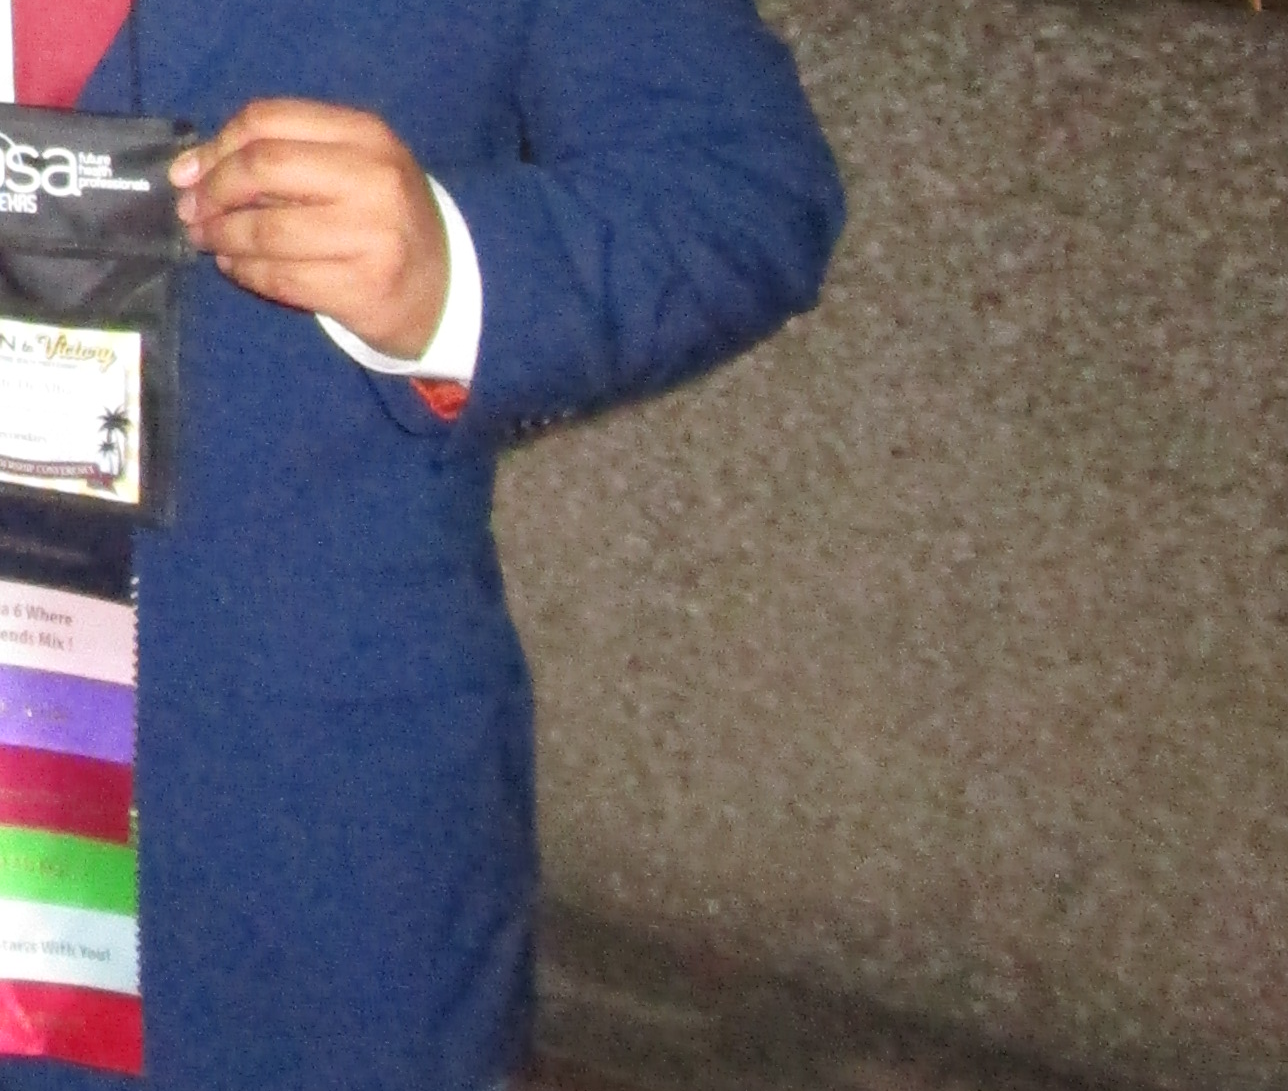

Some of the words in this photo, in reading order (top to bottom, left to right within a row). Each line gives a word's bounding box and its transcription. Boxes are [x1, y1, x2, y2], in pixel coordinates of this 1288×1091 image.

[79, 151, 111, 165] future
[79, 164, 113, 178] health
[79, 176, 151, 192] professionals
[21, 341, 34, 353] to
[37, 333, 118, 373] Victory
[13, 602, 23, 619] 6
[24, 605, 73, 626] Where
[38, 631, 65, 651] Mix
[41, 939, 76, 957] With
[79, 944, 112, 962] You!
